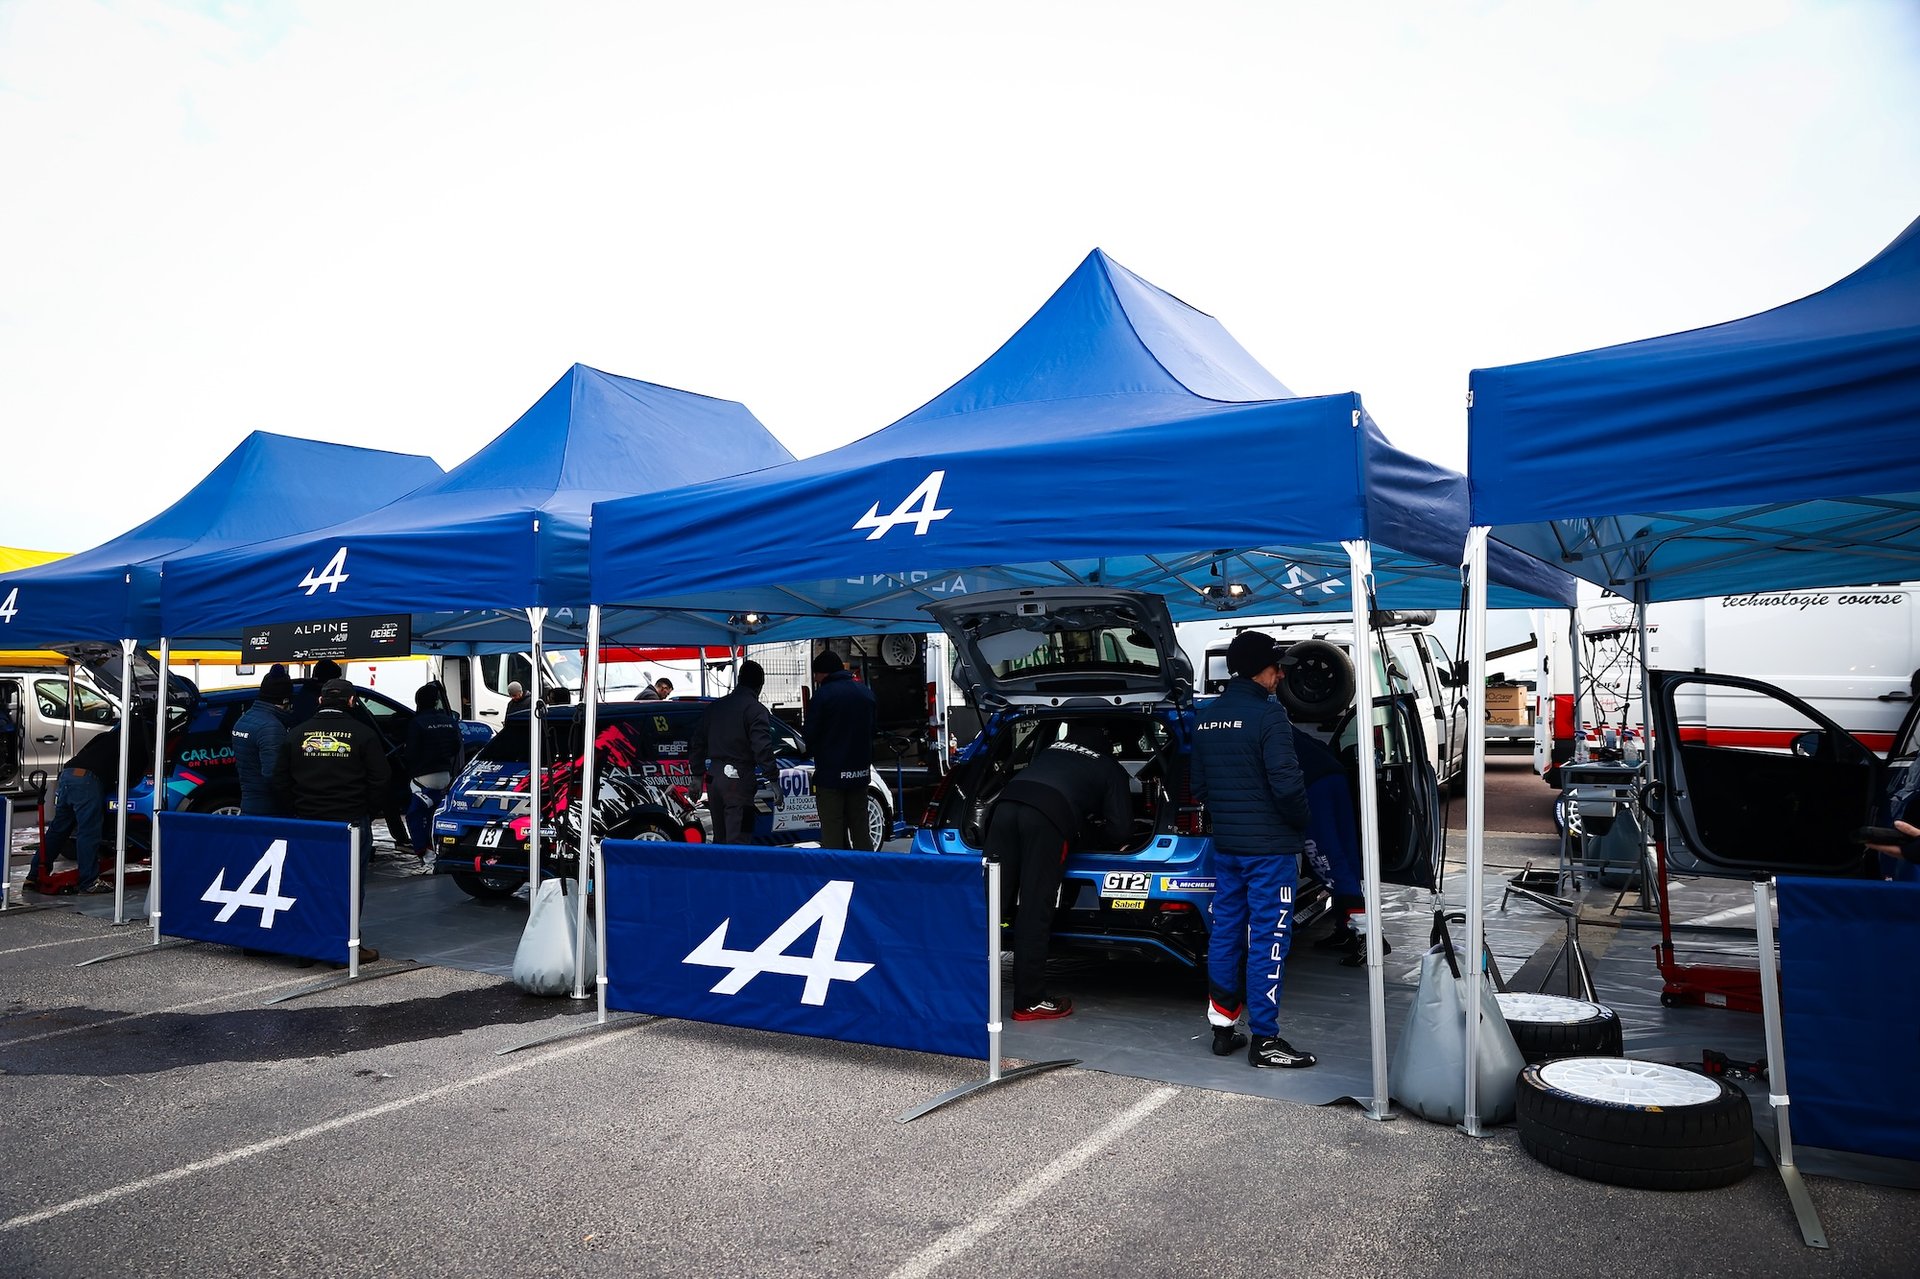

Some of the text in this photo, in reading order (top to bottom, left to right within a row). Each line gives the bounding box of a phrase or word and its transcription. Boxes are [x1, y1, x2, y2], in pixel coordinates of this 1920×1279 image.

[1723, 592, 1902, 611] technologie course
[294, 622, 348, 635] ALPINE
[653, 716, 669, 732] E3
[1197, 720, 1243, 731] ALPINE
[658, 744, 688, 753] DEBEC
[840, 769, 870, 779] FRANCE
[1104, 871, 1151, 890] GT2i
[1114, 900, 1142, 909] Sabelt
[1265, 886, 1292, 1006] ALPINE
